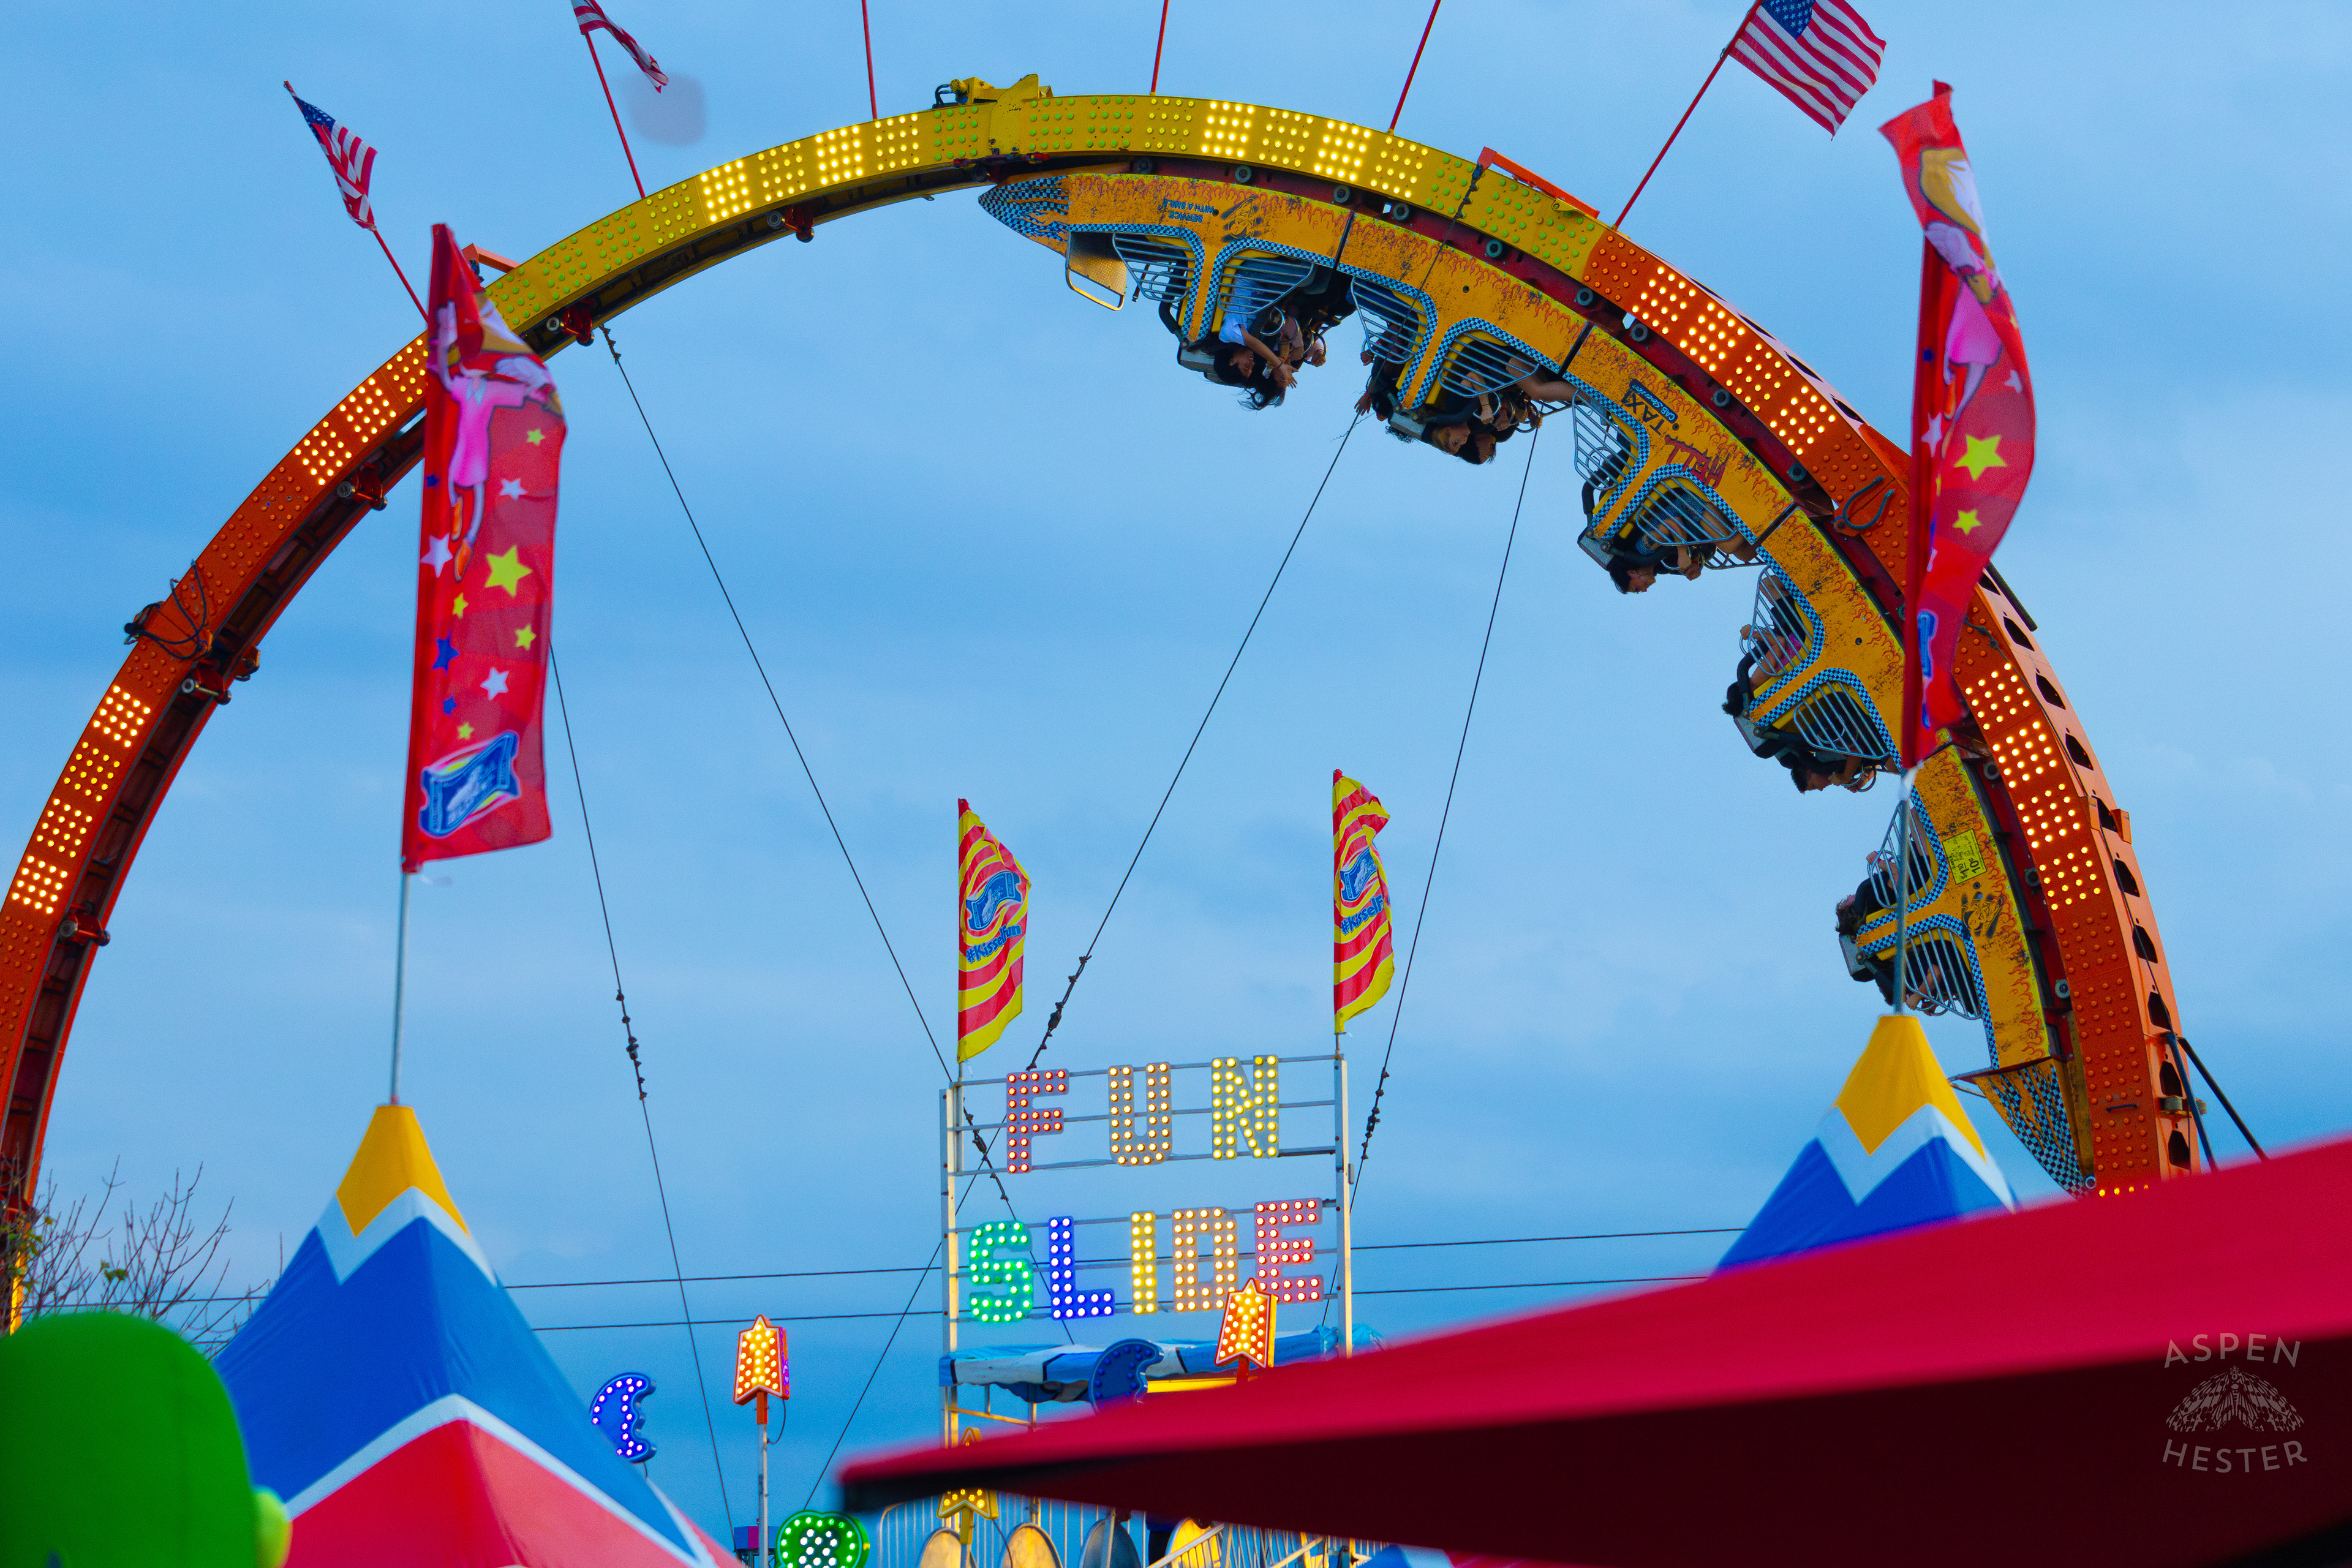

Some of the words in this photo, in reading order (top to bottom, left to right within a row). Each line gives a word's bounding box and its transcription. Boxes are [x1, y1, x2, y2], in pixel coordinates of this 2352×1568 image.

[1163, 199, 1186, 211] SMILE
[1169, 211, 1204, 224] SERVICE
[1194, 204, 1215, 213] WITH
[1621, 388, 1665, 436] TAXI
[1632, 384, 1663, 410] Service
[1660, 407, 1676, 421] CAB
[1664, 434, 1731, 489] HELL
[1341, 894, 1384, 935] #KisselF
[966, 924, 1022, 963] #KisselFun
[1006, 1055, 1280, 1174] FUN
[970, 1198, 1325, 1322] SLIDE
